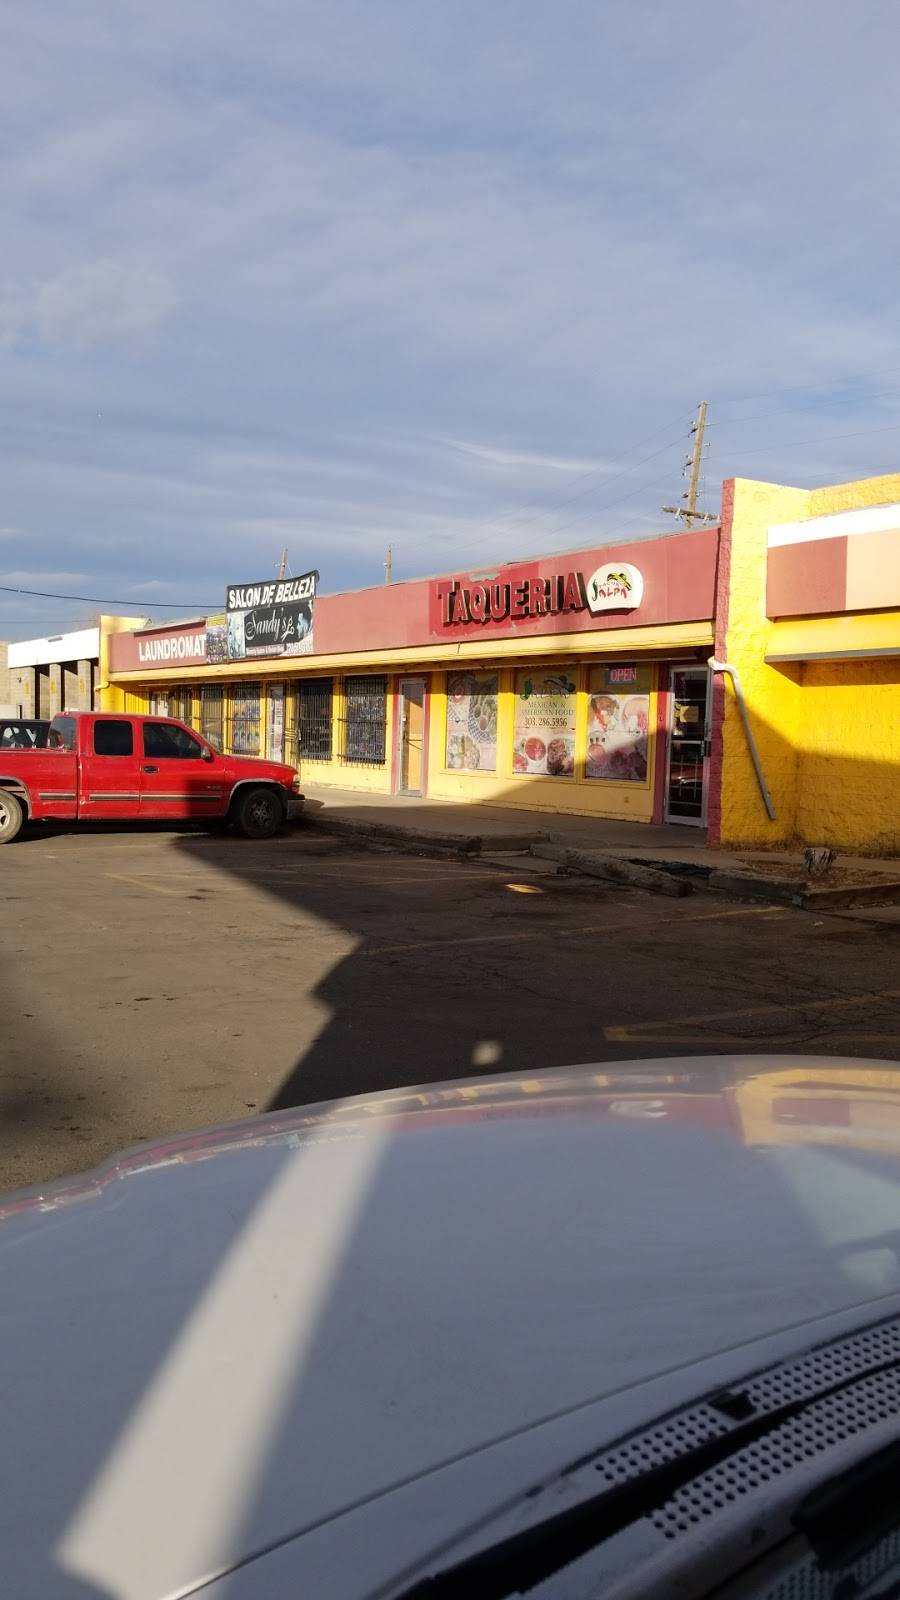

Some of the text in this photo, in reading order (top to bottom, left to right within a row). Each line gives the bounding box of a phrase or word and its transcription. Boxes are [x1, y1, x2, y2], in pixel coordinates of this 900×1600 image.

[229, 575, 315, 609] SALON DE BELLEZA
[437, 572, 584, 623] TAQUERIA
[245, 608, 287, 641] Sandy's
[139, 633, 207, 662] LAUNDROMAT
[610, 668, 636, 681] OPEN
